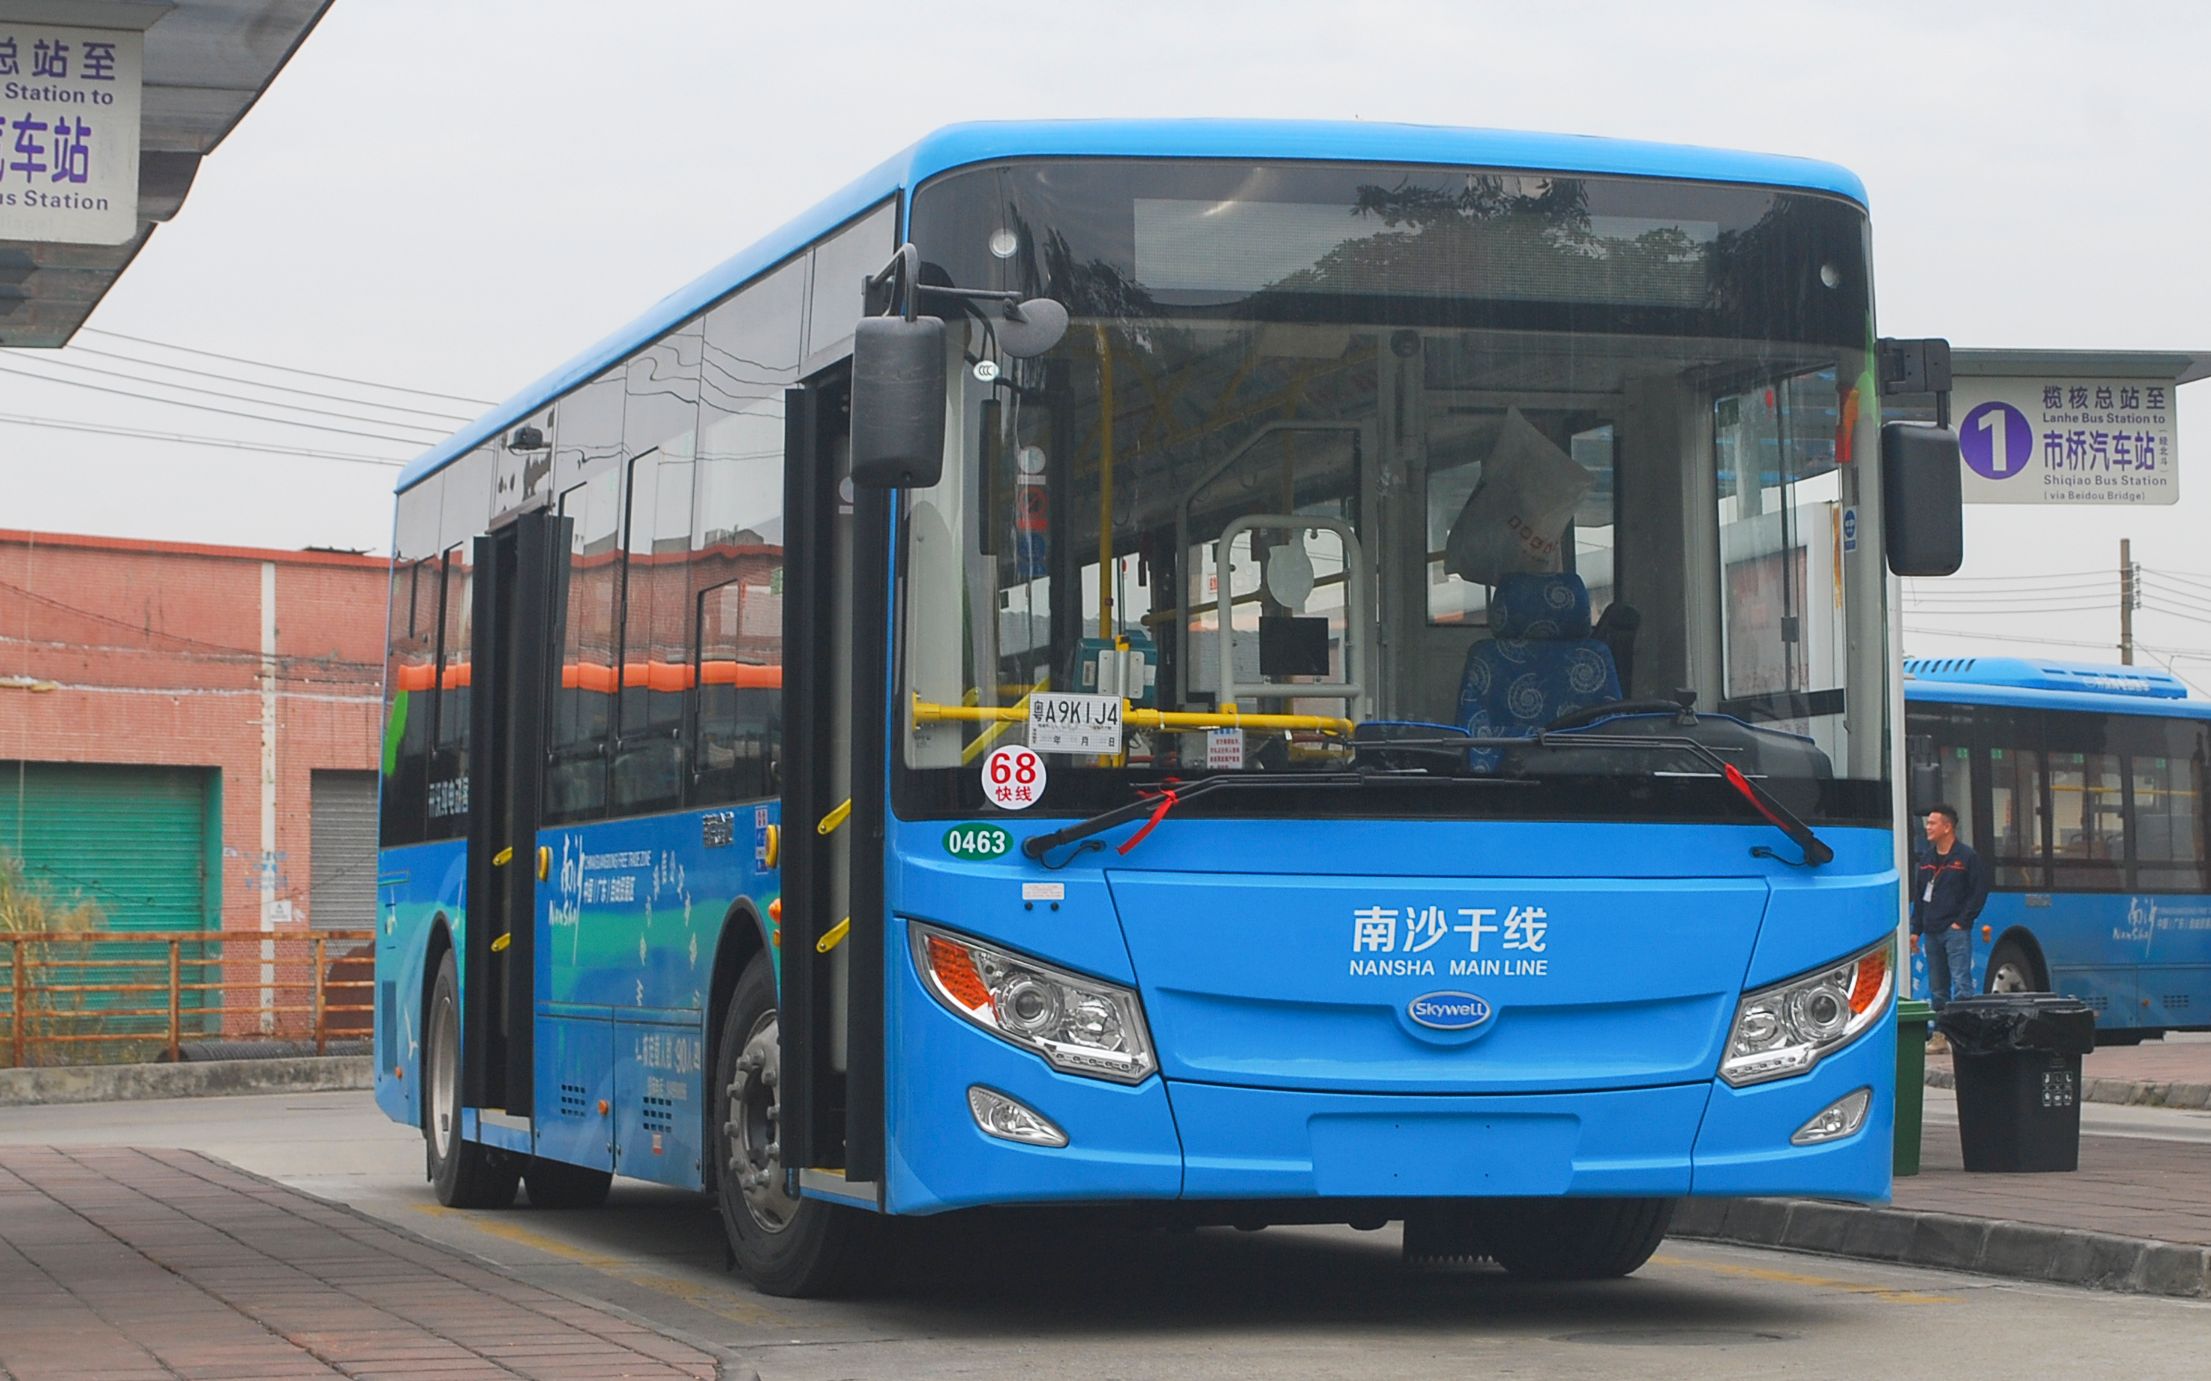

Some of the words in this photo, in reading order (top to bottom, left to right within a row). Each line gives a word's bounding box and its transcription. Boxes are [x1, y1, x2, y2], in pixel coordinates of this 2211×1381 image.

[5, 82, 85, 103] Station
[92, 89, 114, 105] to
[0, 112, 92, 184] 车站
[24, 189, 109, 211] Station
[2042, 385, 2166, 410] 榄核总站至
[2043, 413, 2079, 423] Lanhe
[2082, 413, 2104, 424] Bus
[2106, 413, 2150, 424] Station
[2153, 414, 2166, 424] to
[1978, 409, 2007, 471] 1
[2043, 429, 2156, 472] 市桥汽车站
[2044, 475, 2092, 487] Shiqiao
[2095, 475, 2118, 486] Bus
[2121, 475, 2167, 486] Station
[2068, 491, 2105, 500] Beidou
[990, 752, 1037, 784] 68
[995, 786, 1032, 802] 快线
[949, 831, 1006, 854] 0463
[1353, 905, 1548, 953] 南沙干线
[1350, 960, 1435, 976] NANSHA
[1449, 960, 1500, 976] MAIN
[1504, 960, 1548, 976] LINE
[1415, 1003, 1485, 1017] Skywell
